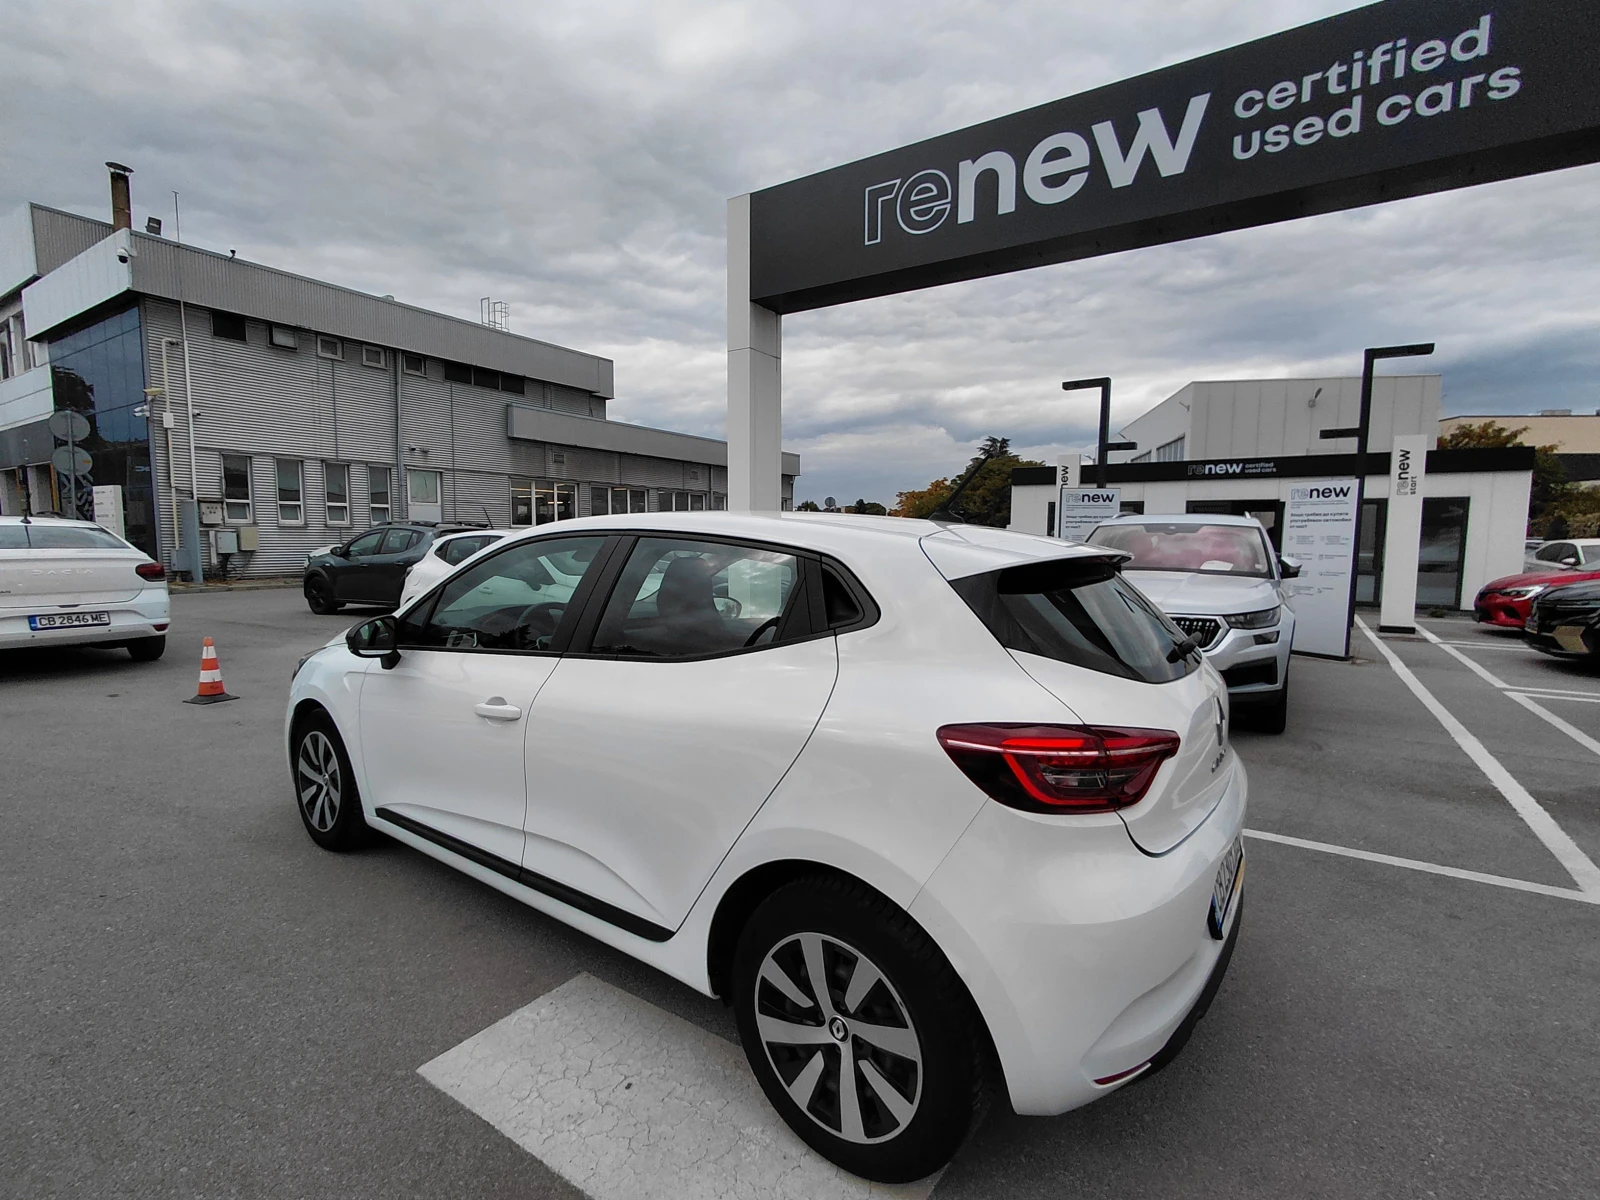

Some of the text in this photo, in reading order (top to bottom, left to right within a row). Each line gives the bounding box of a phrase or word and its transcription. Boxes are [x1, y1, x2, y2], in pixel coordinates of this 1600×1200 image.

[1233, 14, 1492, 119] certified
[1232, 65, 1522, 160] used cars
[863, 92, 1211, 246] renew
[1187, 462, 1243, 476] renew
[1244, 461, 1275, 469] certified
[1395, 449, 1411, 496] renew
[1060, 465, 1069, 489] new
[1410, 475, 1418, 496] start
[1066, 493, 1115, 503] renew
[1291, 486, 1351, 500] renew
[38, 613, 107, 627] CB 2846 ME
